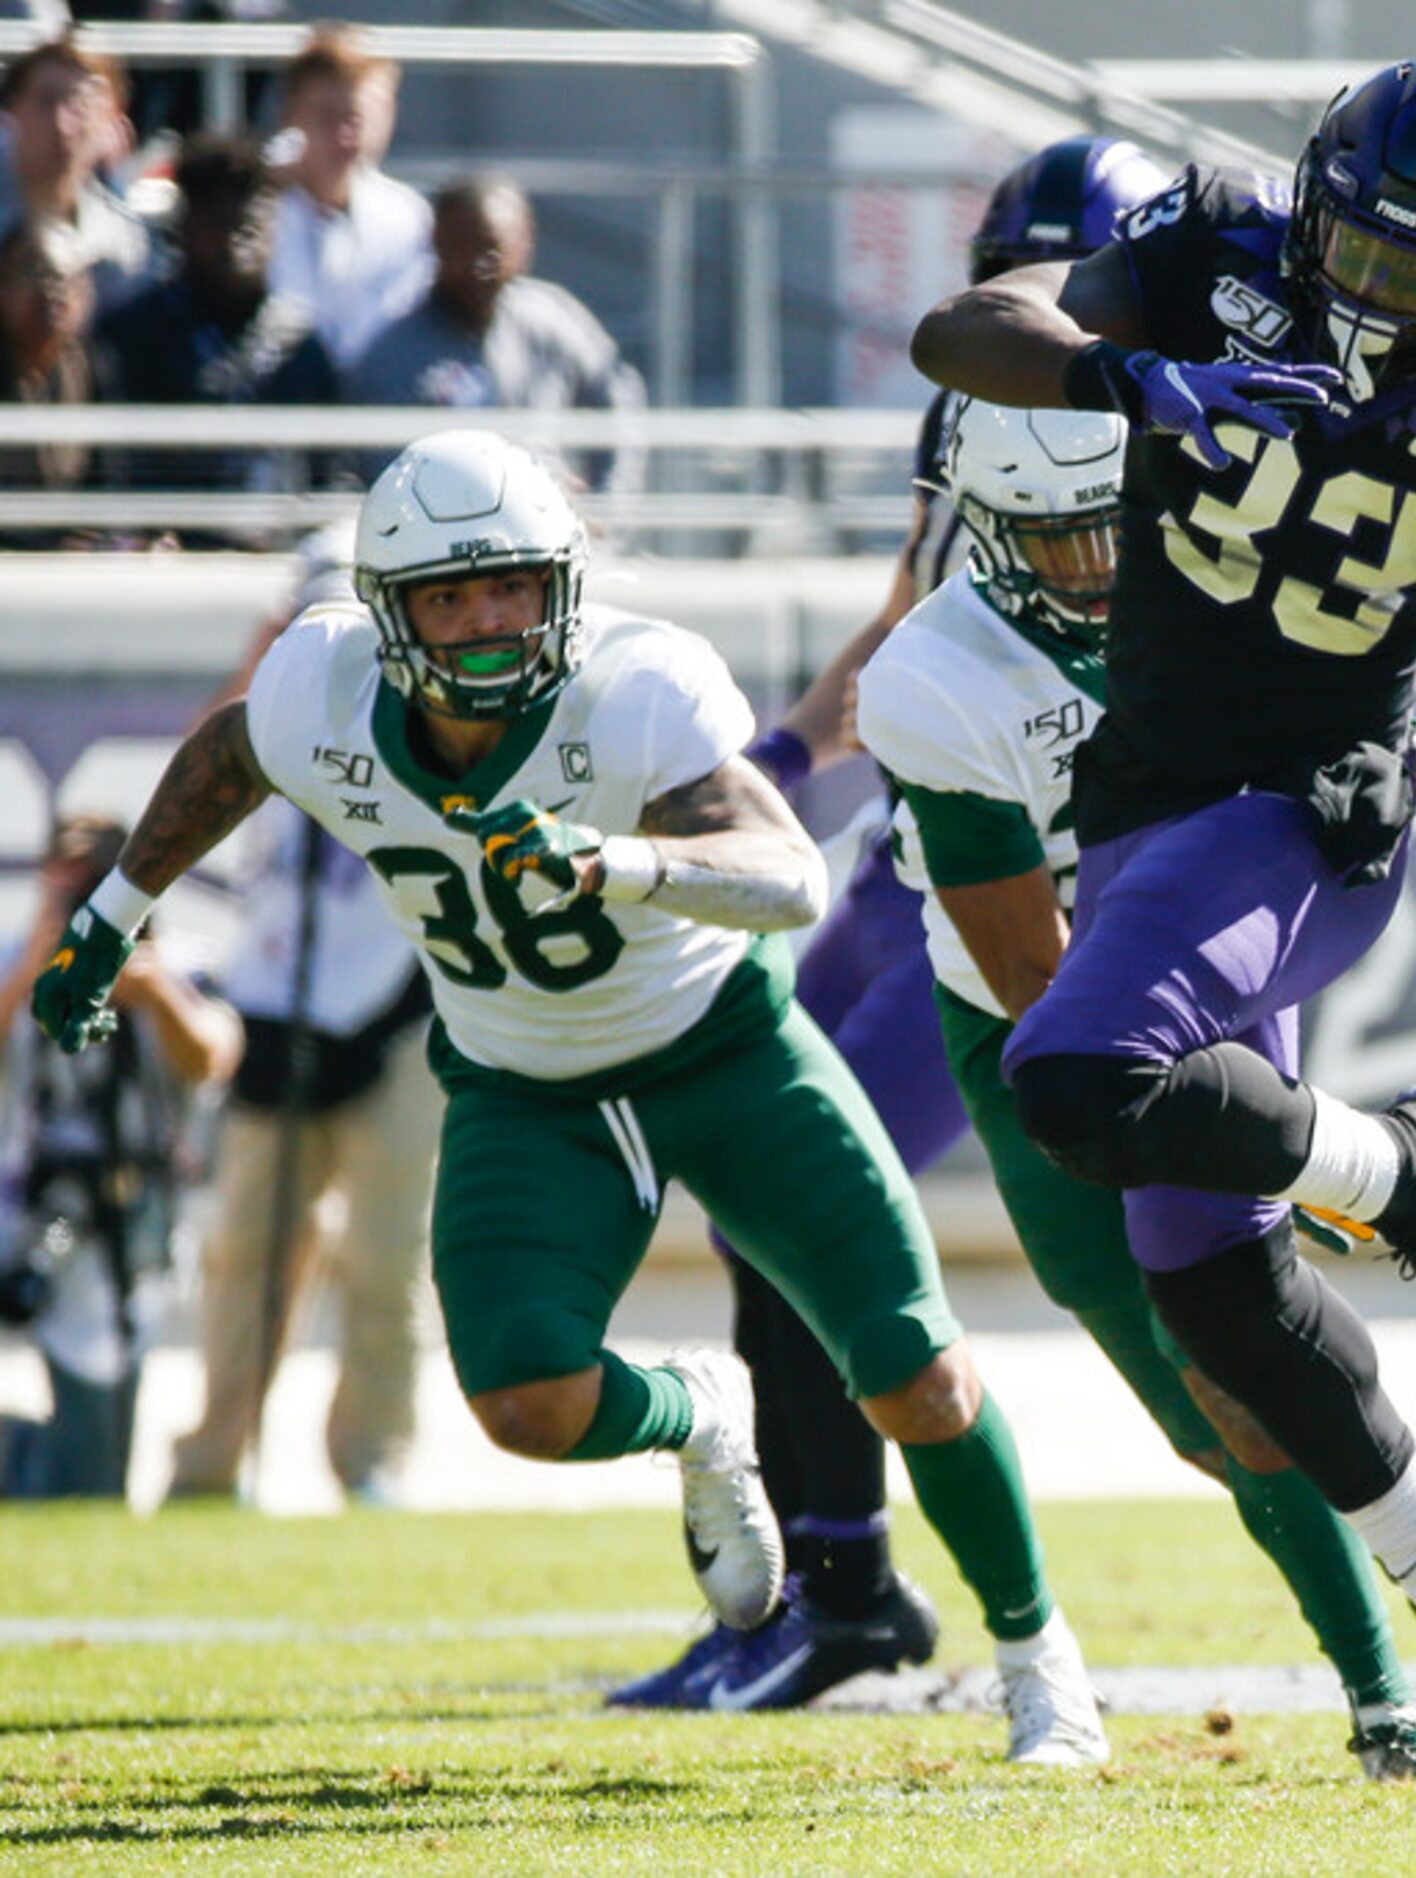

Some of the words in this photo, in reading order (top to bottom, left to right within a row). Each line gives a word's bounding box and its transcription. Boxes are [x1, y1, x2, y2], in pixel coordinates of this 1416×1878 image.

[1074, 481, 1118, 505] BEARS
[565, 747, 589, 780] C
[340, 797, 383, 825] XII
[365, 846, 626, 992] 38
